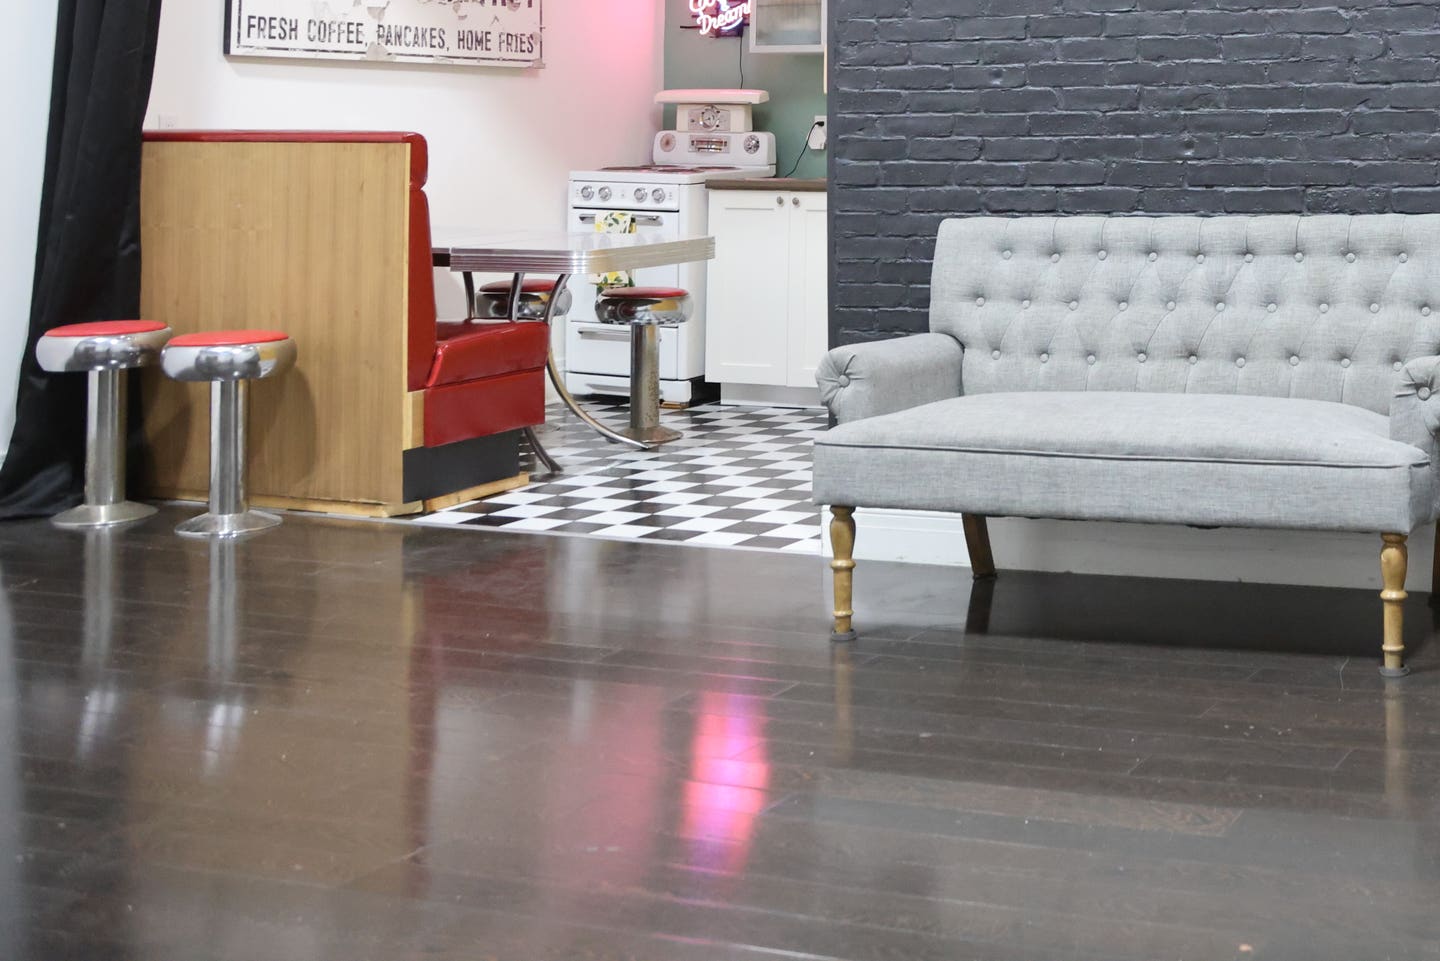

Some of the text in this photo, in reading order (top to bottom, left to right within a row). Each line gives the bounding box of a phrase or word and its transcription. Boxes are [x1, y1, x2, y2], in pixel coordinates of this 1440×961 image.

[247, 15, 534, 54] FRESH COFFEE, PANCAKES, HOME FRIES
